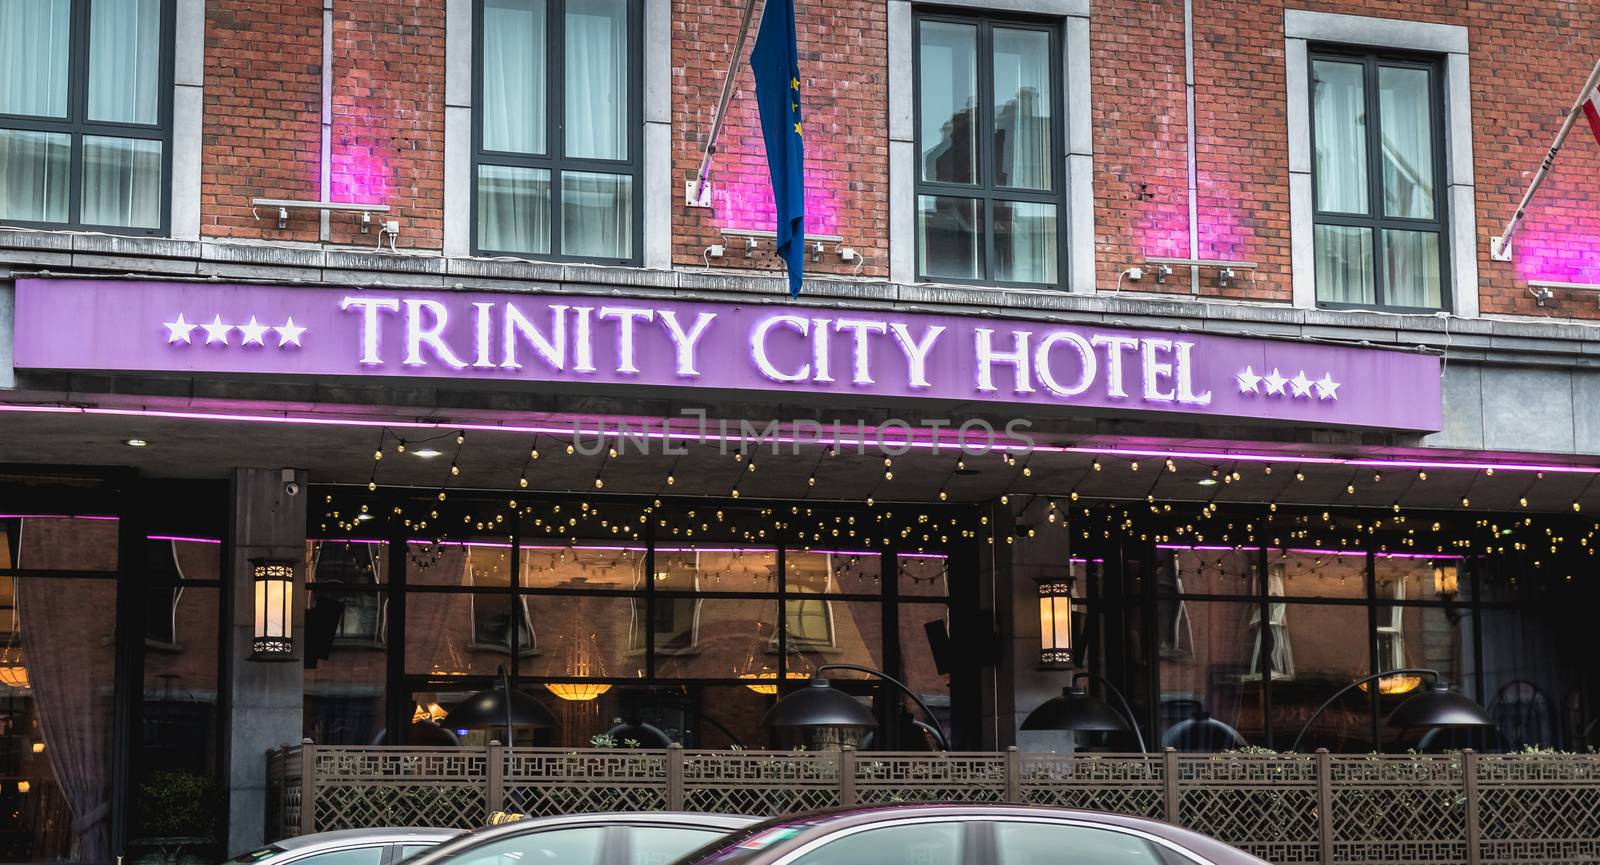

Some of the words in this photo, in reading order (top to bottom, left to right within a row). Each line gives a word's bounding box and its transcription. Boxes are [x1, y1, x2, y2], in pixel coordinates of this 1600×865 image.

[341, 296, 717, 375] TRINITY
[751, 315, 946, 387] CITY
[974, 328, 1211, 405] HOTEL
